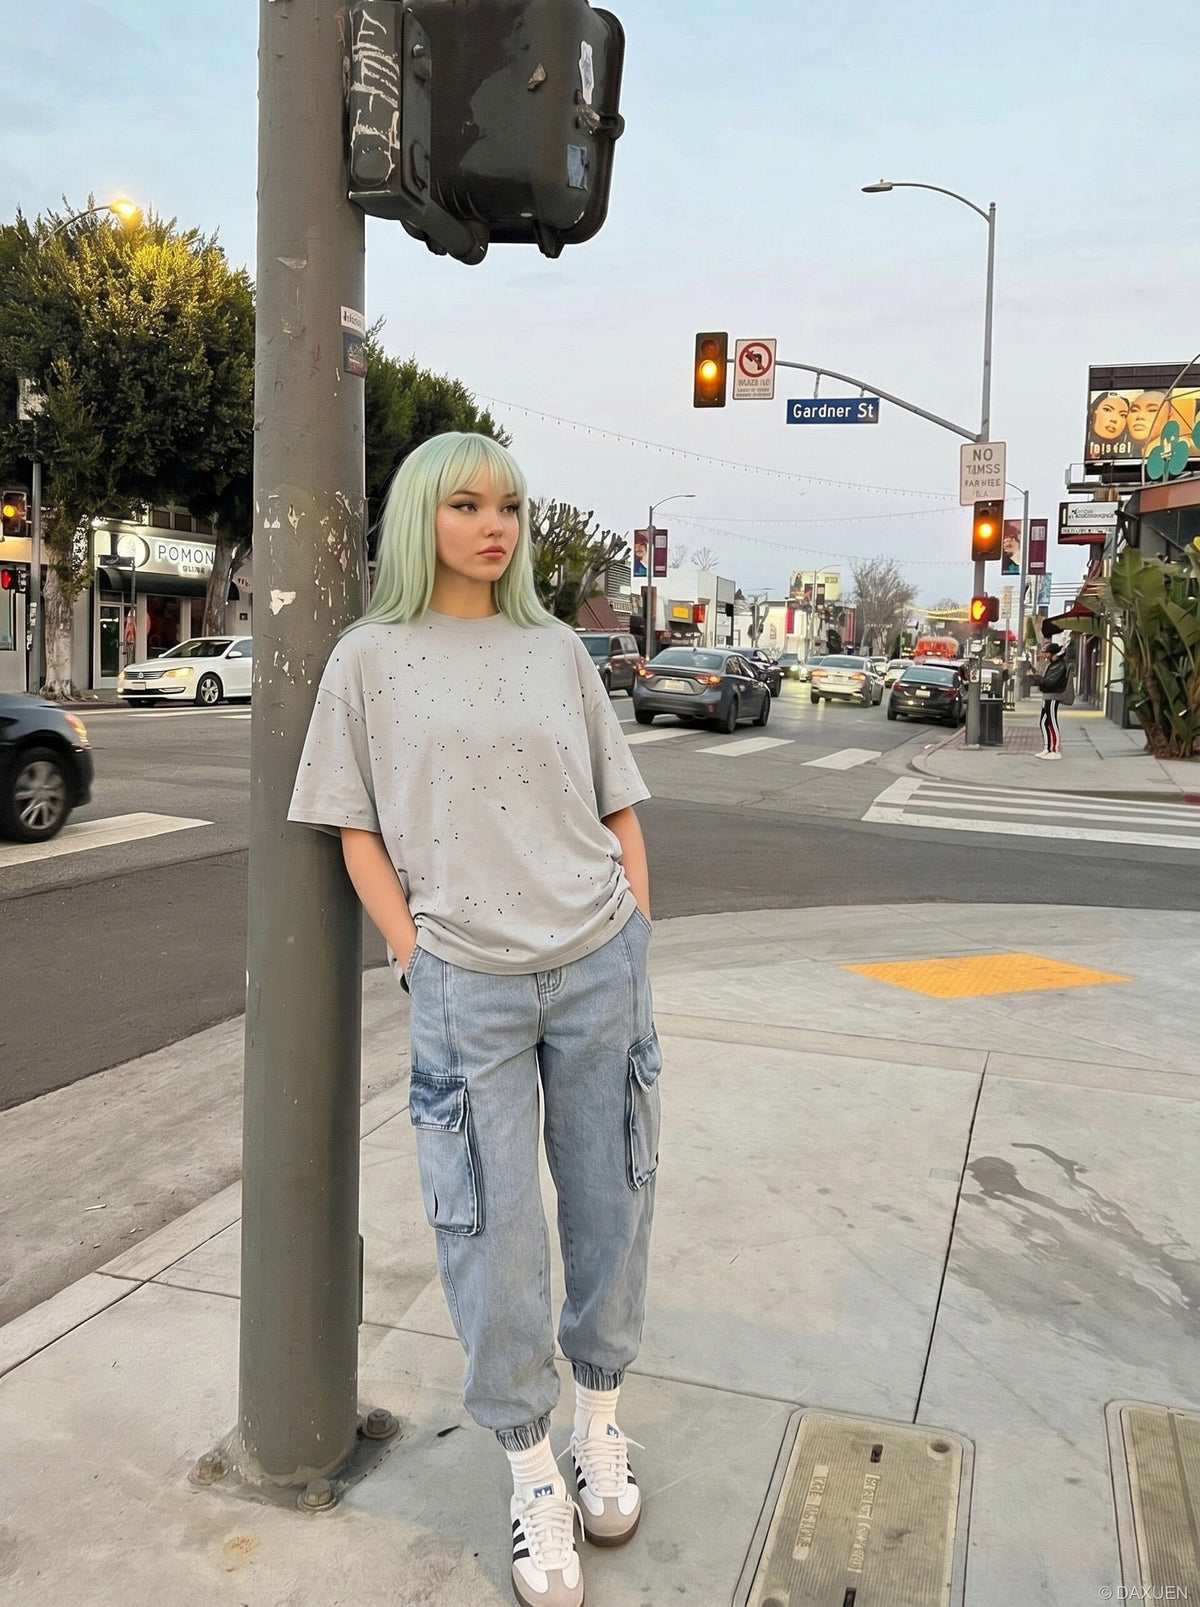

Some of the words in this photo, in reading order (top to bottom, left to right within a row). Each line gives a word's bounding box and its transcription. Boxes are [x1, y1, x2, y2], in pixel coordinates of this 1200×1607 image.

[793, 403, 851, 418] Gardner
[857, 402, 874, 418] St
[973, 448, 993, 461] NO
